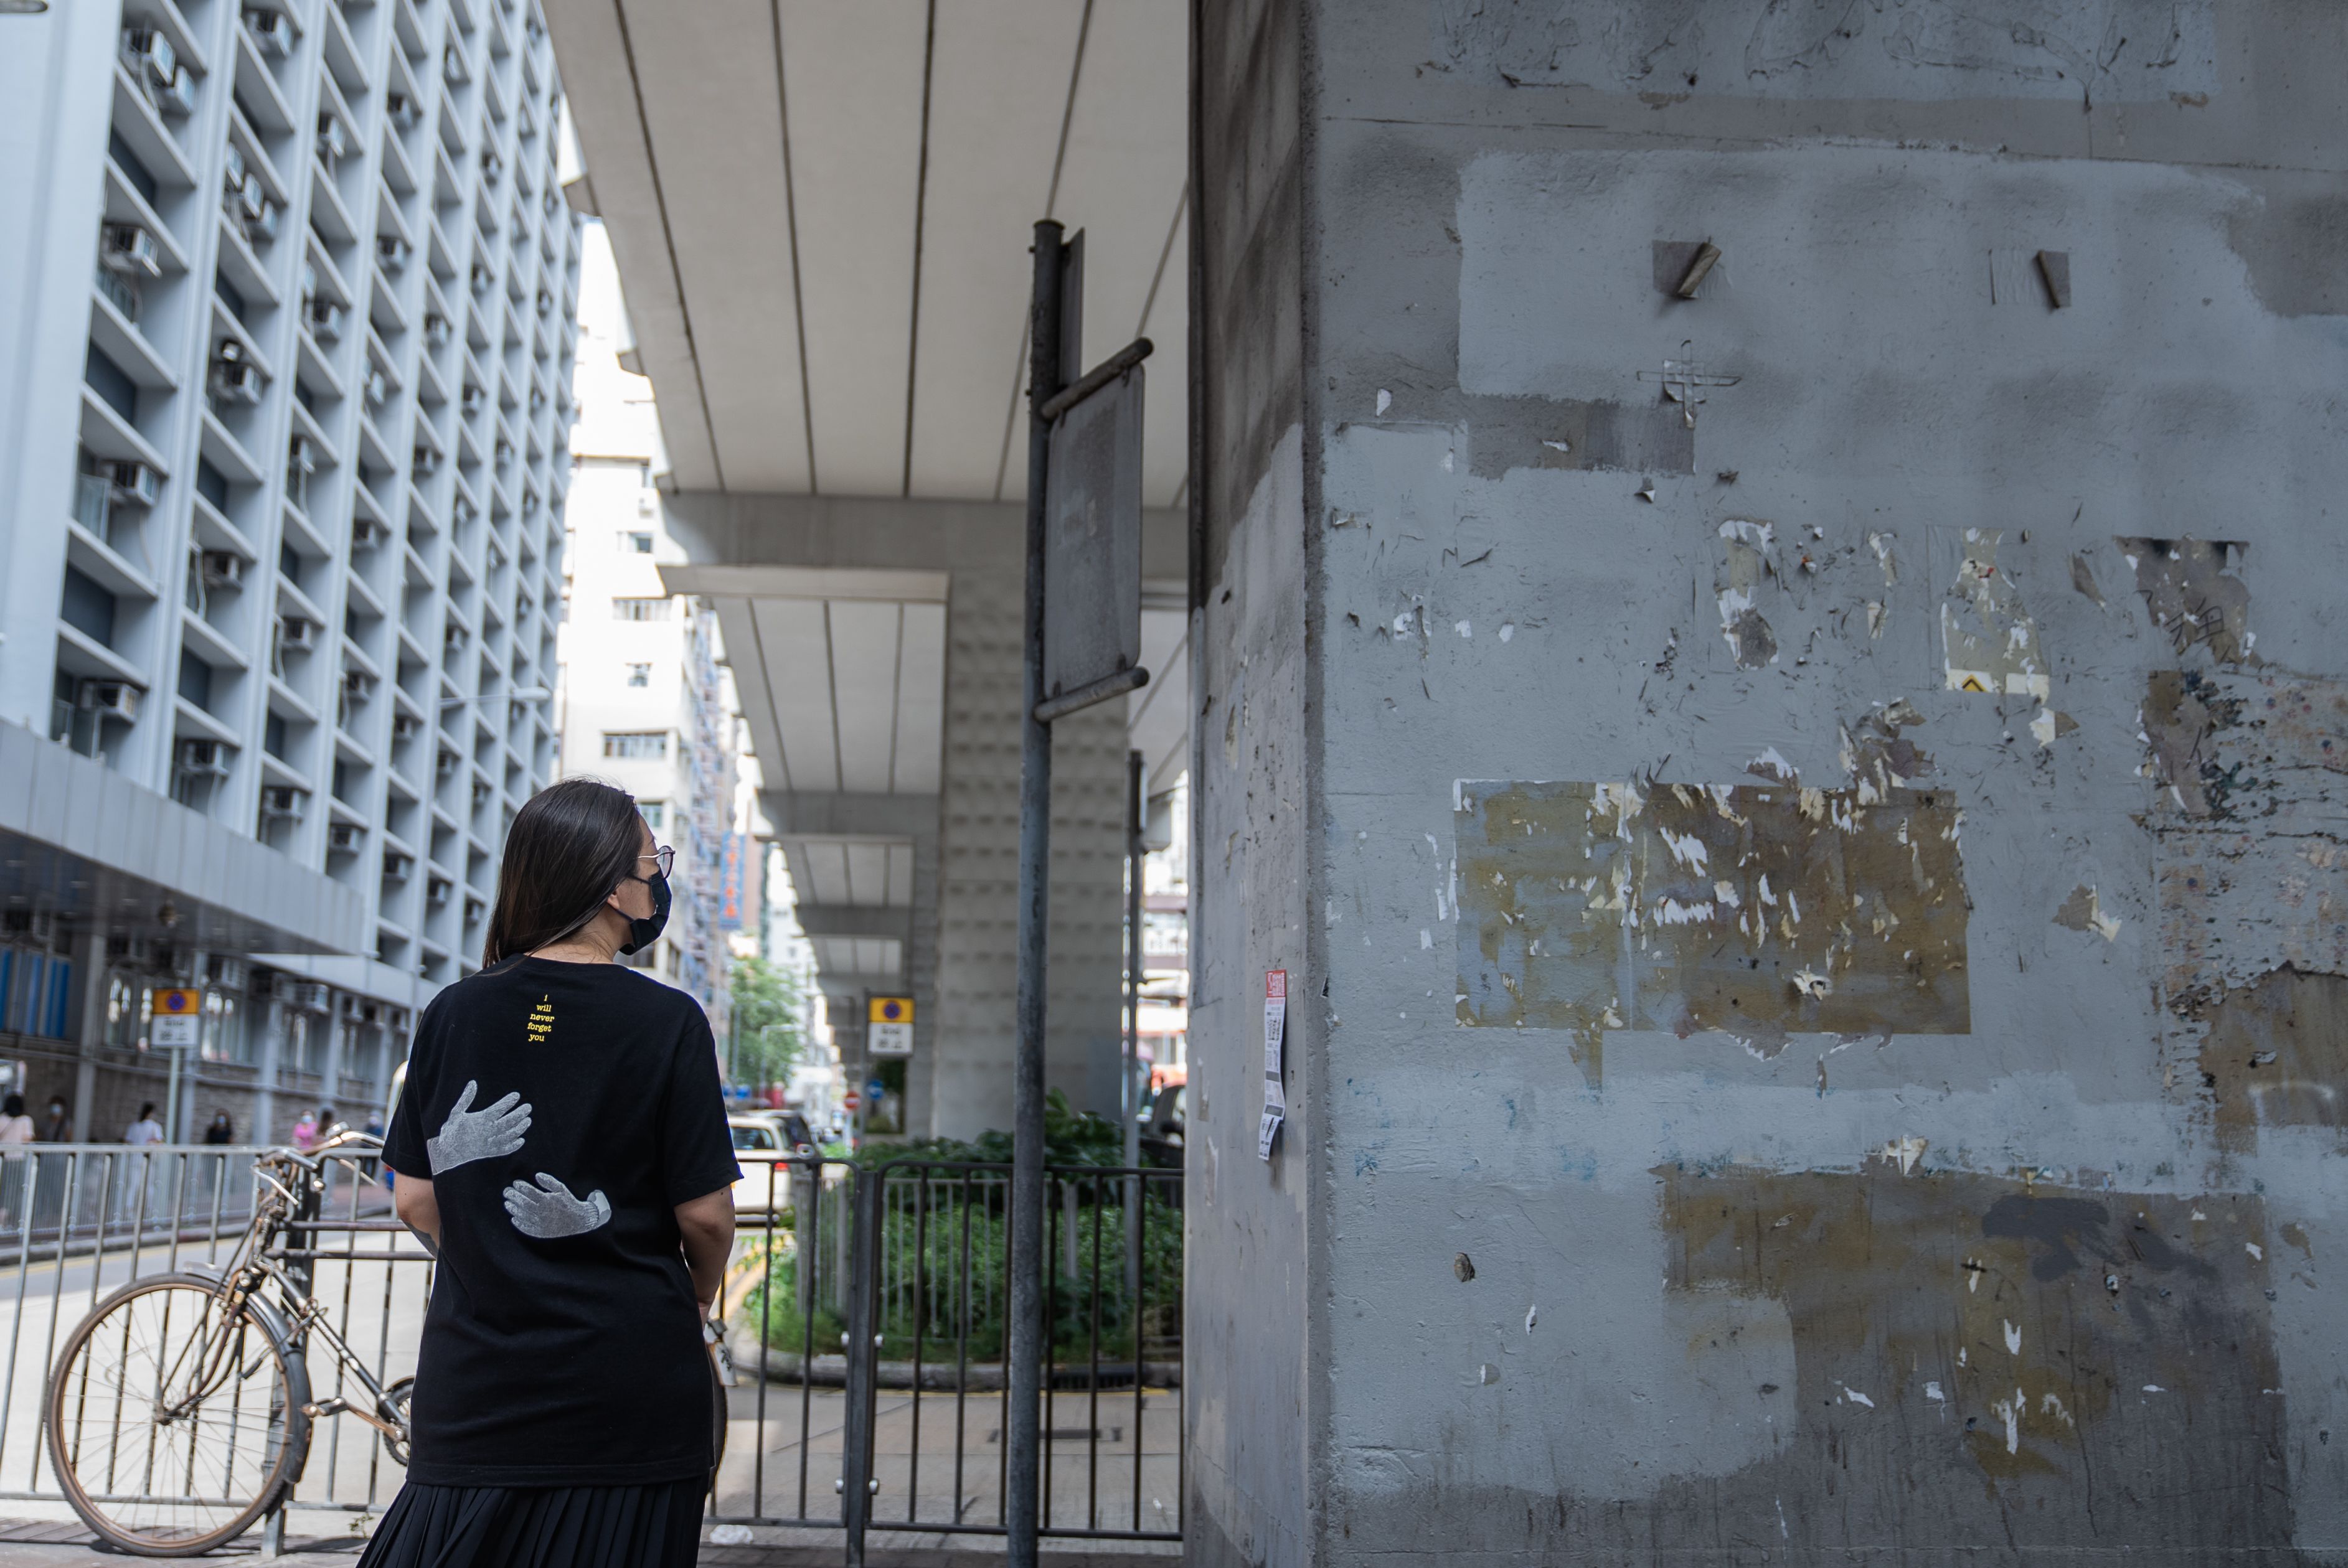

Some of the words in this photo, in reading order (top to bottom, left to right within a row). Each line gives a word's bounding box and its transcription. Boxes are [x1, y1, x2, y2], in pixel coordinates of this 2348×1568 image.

[536, 1004, 552, 1012] will
[529, 1013, 555, 1022] never
[527, 1021, 552, 1033] forget
[528, 1033, 545, 1042] you
